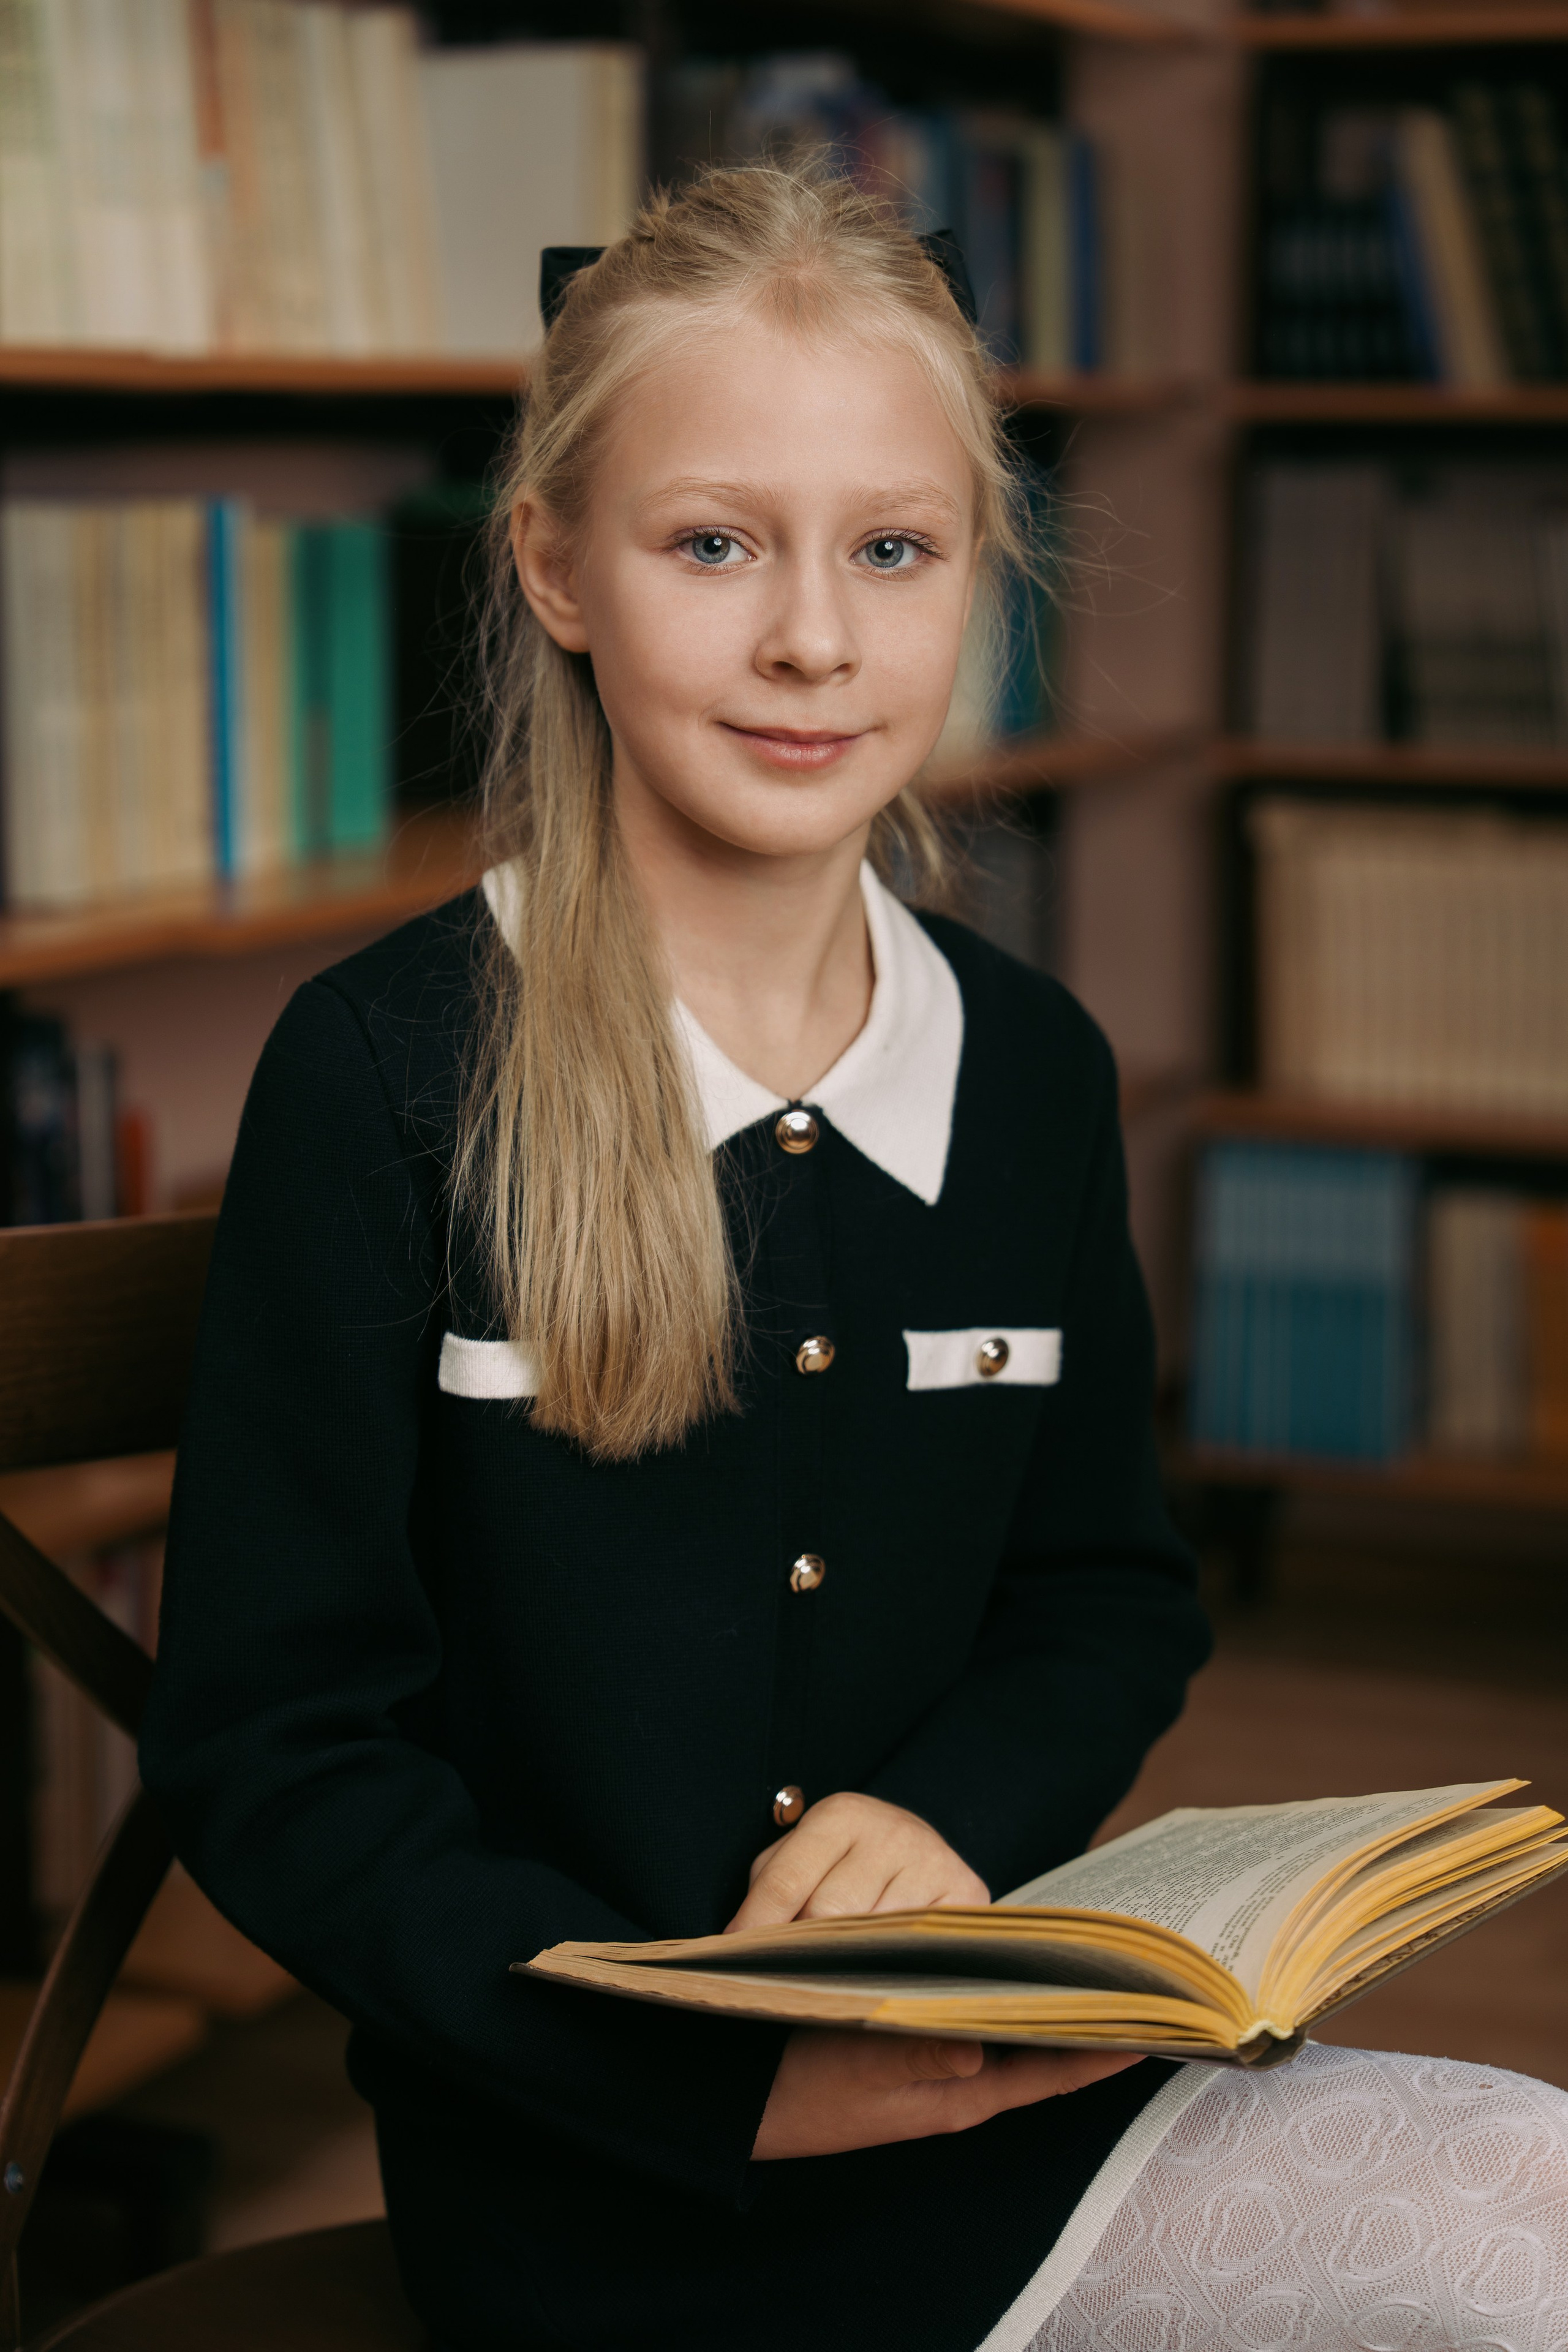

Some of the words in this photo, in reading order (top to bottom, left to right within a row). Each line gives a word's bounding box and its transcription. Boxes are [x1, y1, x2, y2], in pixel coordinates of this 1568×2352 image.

[1161, 1883, 1197, 1909] Больной
[1175, 1893, 1195, 1909] ночь
[1170, 1901, 1200, 1931] больны
[1176, 1899, 1208, 1933] соседней
